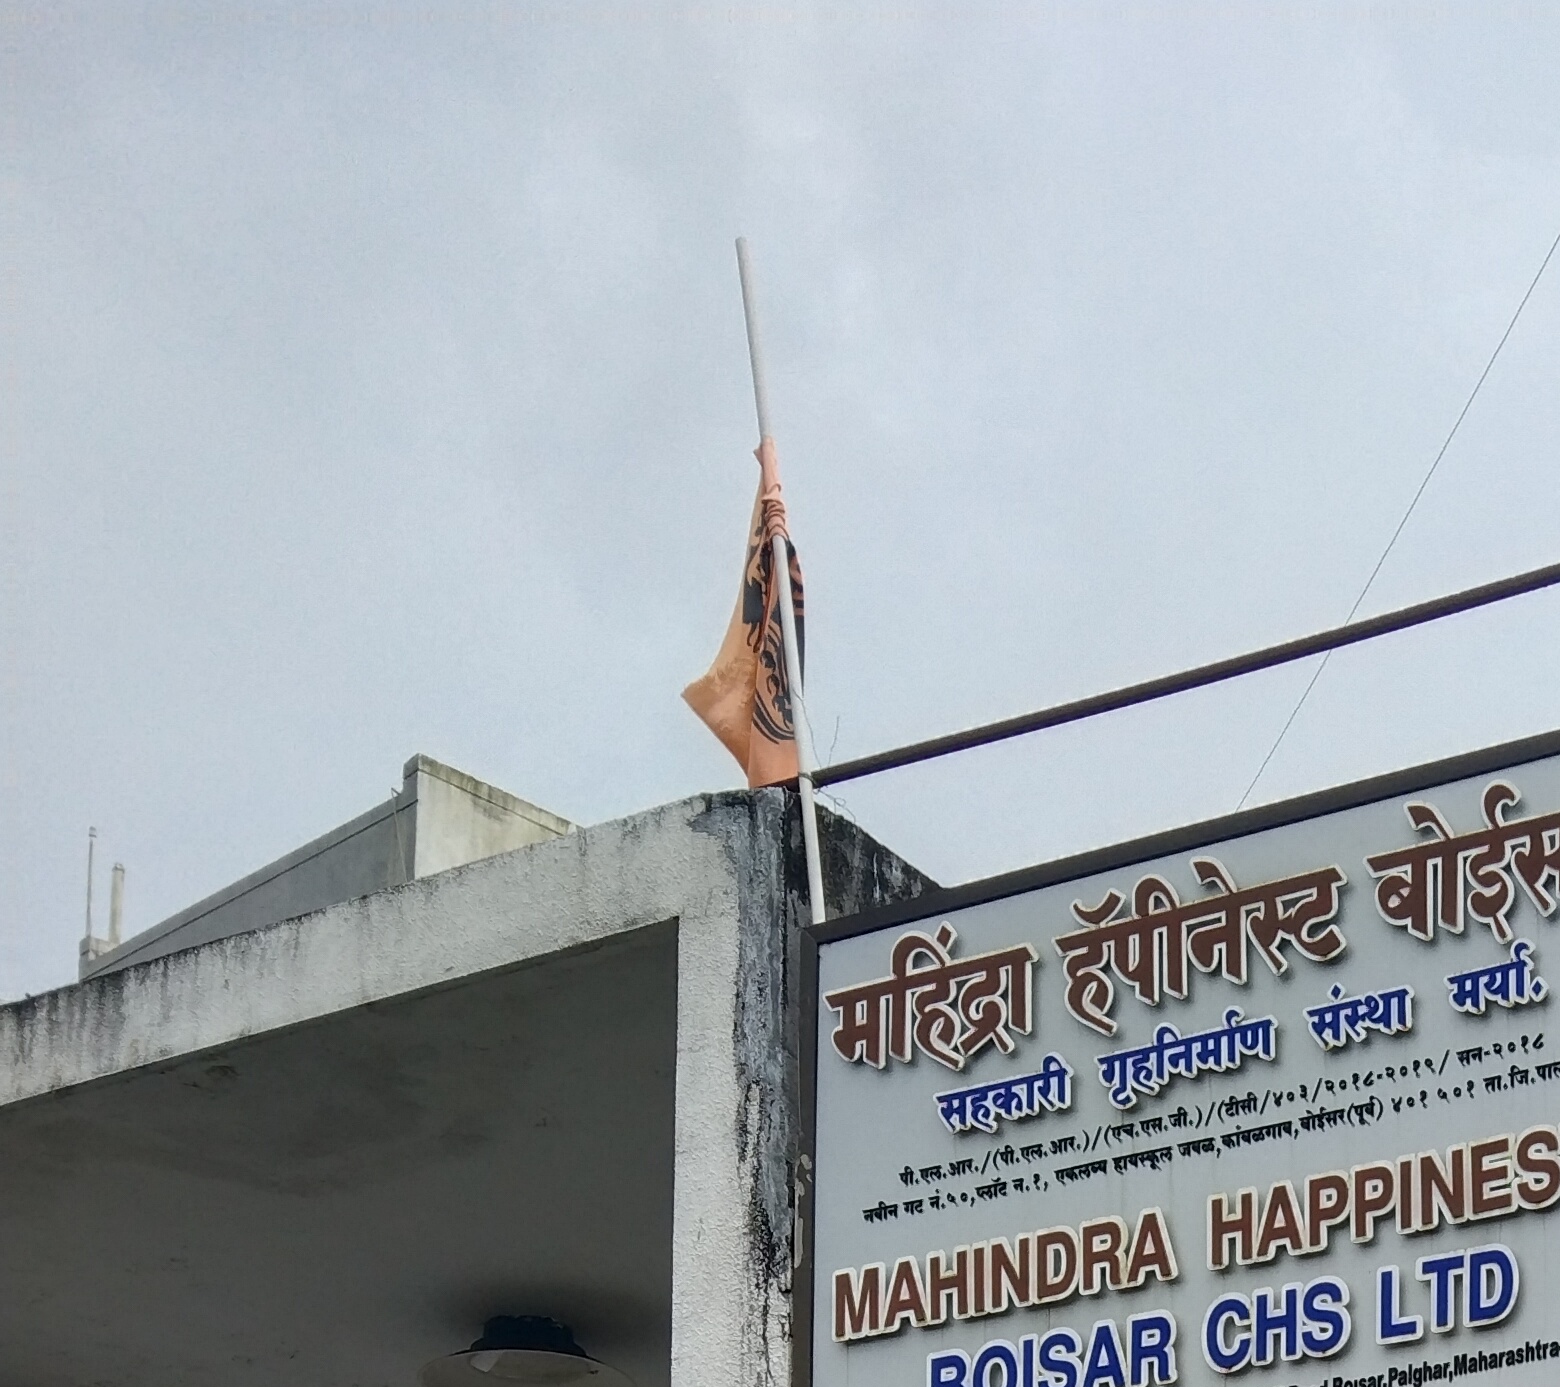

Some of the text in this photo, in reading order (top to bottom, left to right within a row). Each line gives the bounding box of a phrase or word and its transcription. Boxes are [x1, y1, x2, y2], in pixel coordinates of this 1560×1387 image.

[824, 922, 1038, 1069] महिंद्रा
[1053, 857, 1347, 1035] हॅपीनेस्ट
[934, 939, 1549, 1132] सहकारी गृहनिर्माण संस्था मर्या.
[903, 1198, 924, 1215] गट
[832, 1207, 1178, 1342] MAHINDRA
[1202, 1274, 1351, 1373] CHS
[1376, 1243, 1519, 1346] LTD
